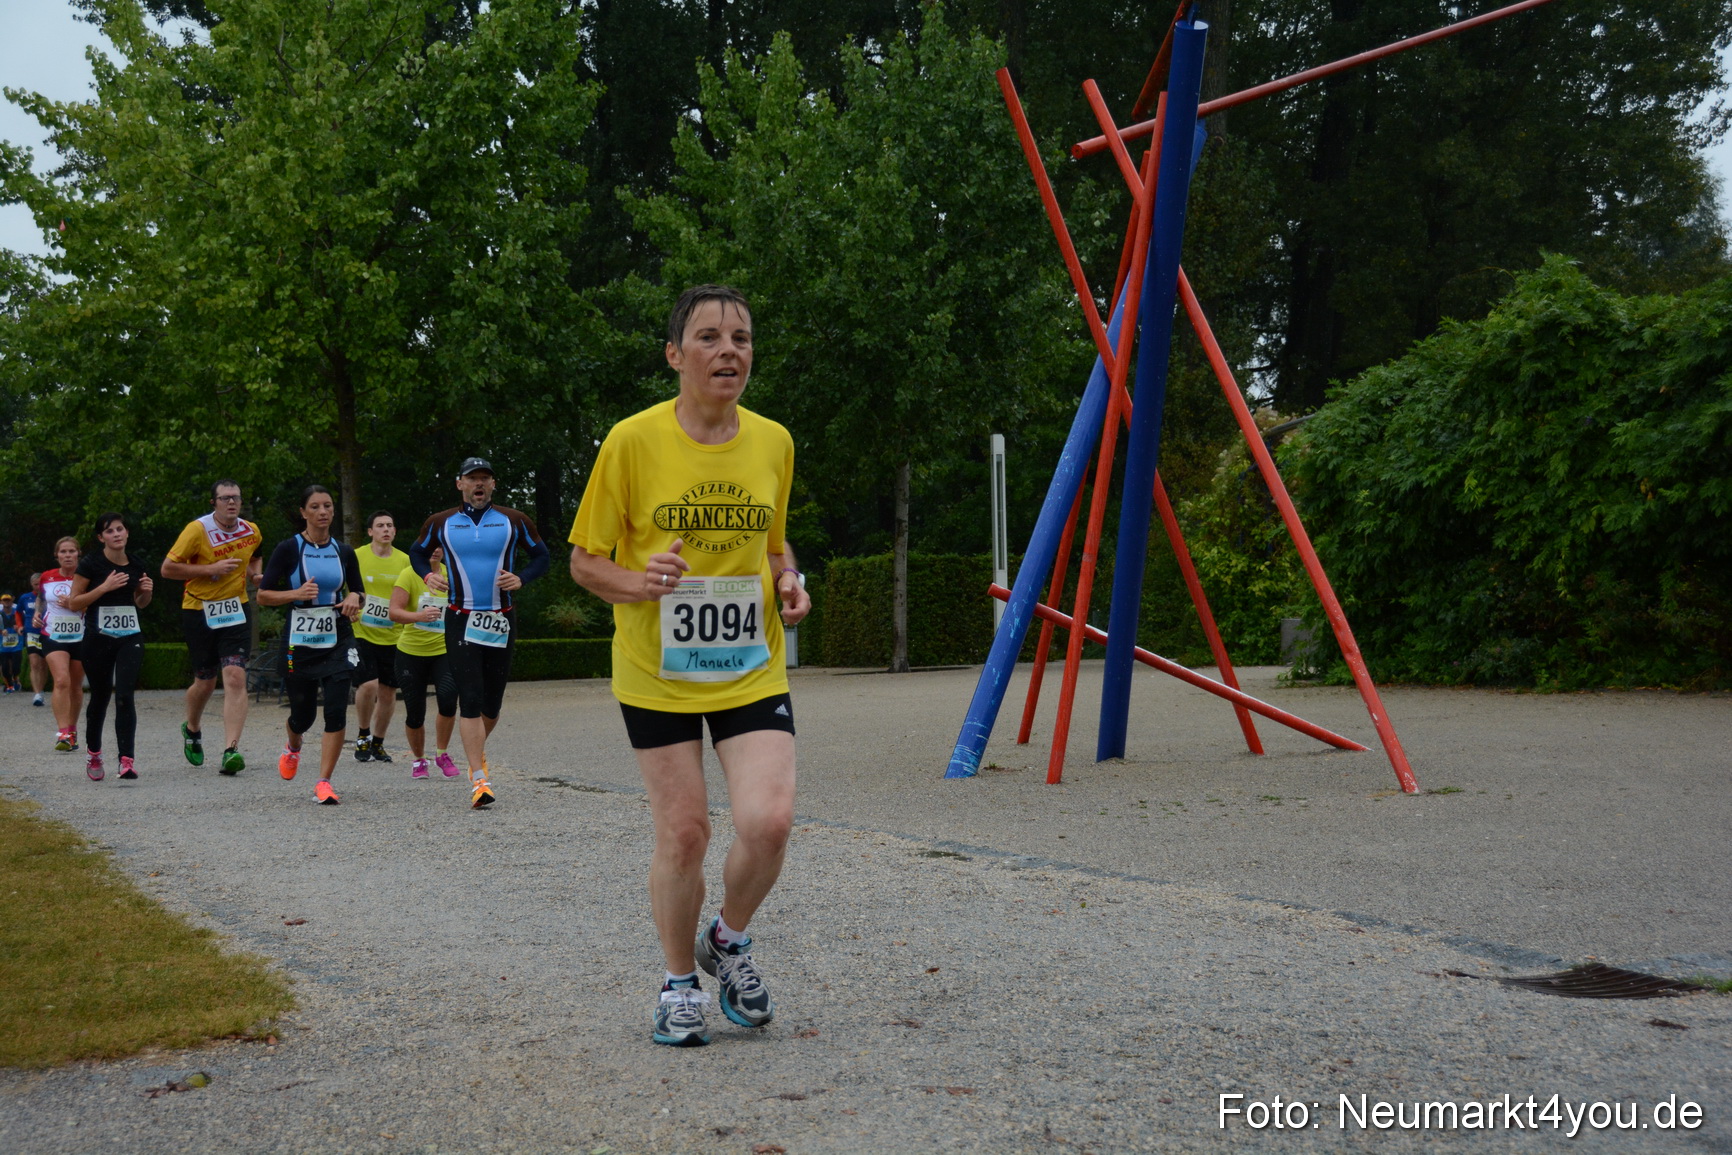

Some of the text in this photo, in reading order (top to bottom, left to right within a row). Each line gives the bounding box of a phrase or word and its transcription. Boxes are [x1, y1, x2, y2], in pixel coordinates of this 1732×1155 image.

[682, 483, 752, 505] PIZZERIA
[667, 507, 767, 529] FRANCESCO
[682, 531, 751, 552] HERSBRUCK
[214, 546, 235, 558] MAX
[713, 580, 756, 594] BOCK
[208, 600, 239, 616] 2769
[54, 622, 81, 633] 2030
[103, 615, 136, 629] 2305
[296, 616, 333, 633] 2748
[472, 612, 508, 633] 3043
[673, 602, 758, 642] 3094
[302, 635, 326, 643] Barbara
[686, 651, 745, 669] Manuela
